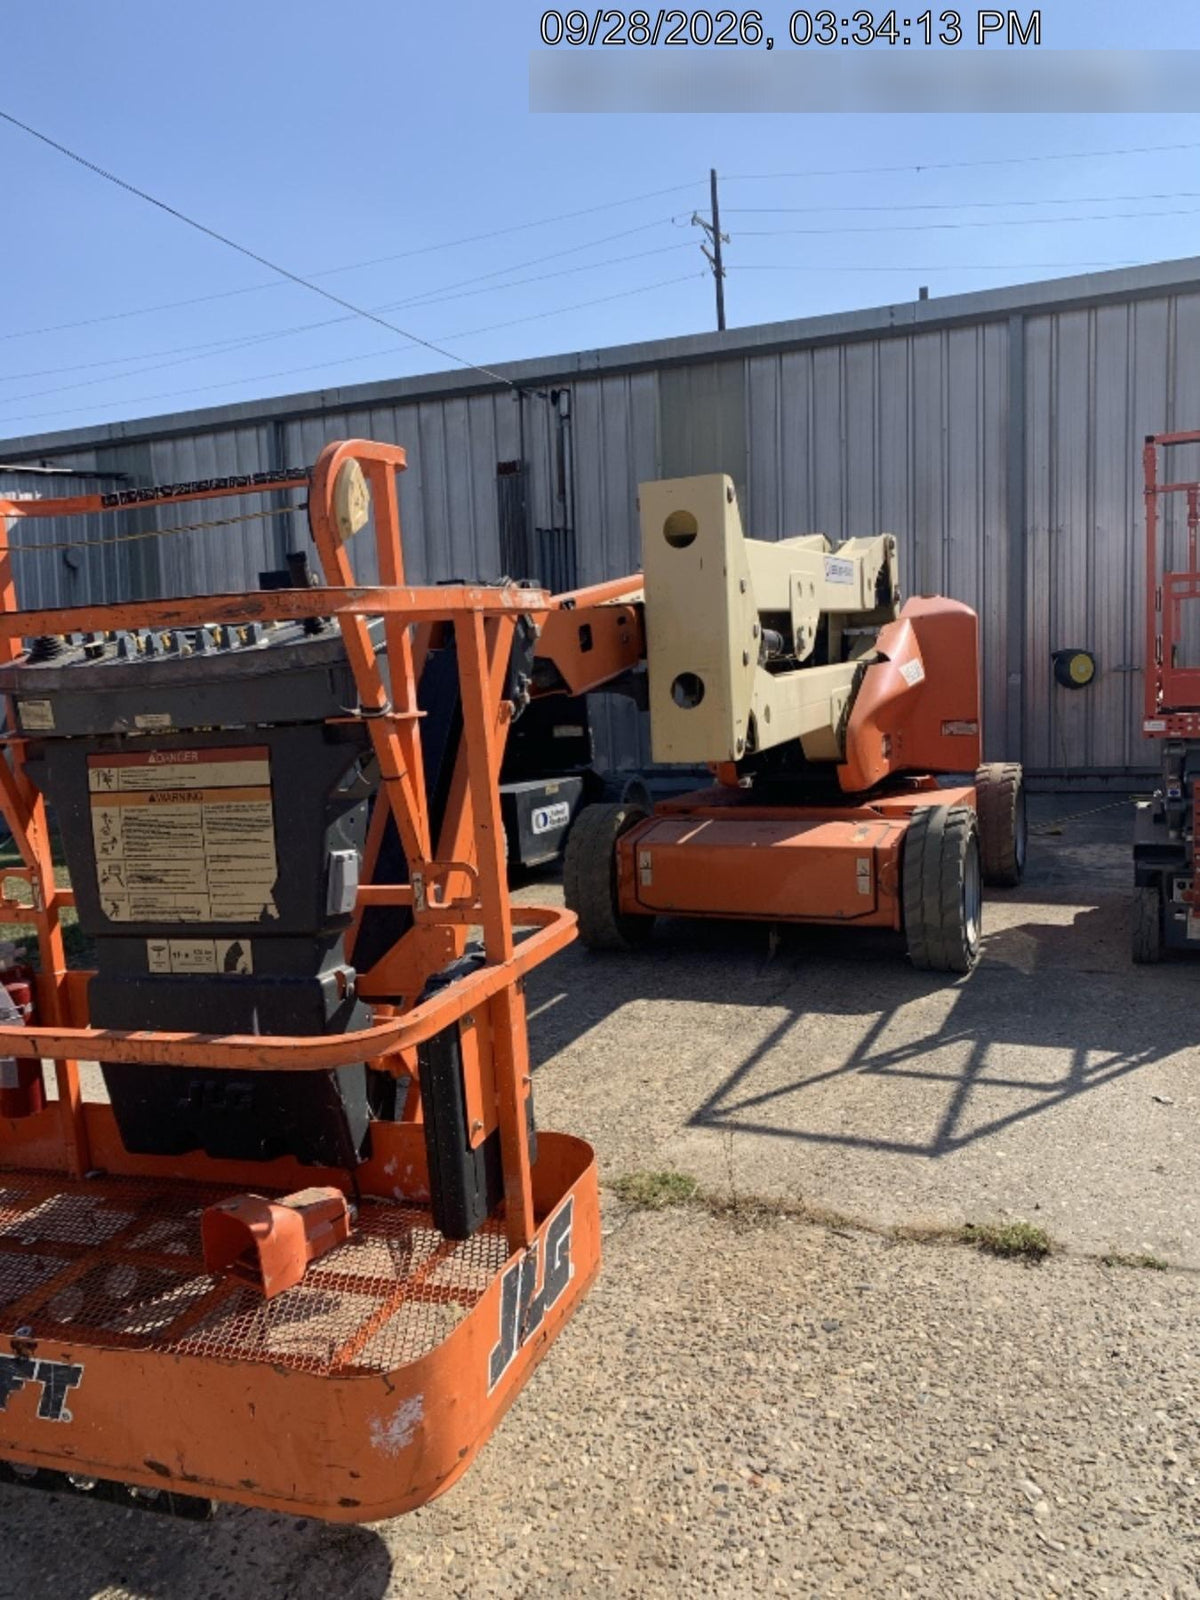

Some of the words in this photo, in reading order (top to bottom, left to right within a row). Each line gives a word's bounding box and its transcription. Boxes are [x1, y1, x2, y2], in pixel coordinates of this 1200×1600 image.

[155, 752, 199, 763] DANGER
[156, 792, 204, 803] WARNING
[486, 1193, 576, 1398] JLG
